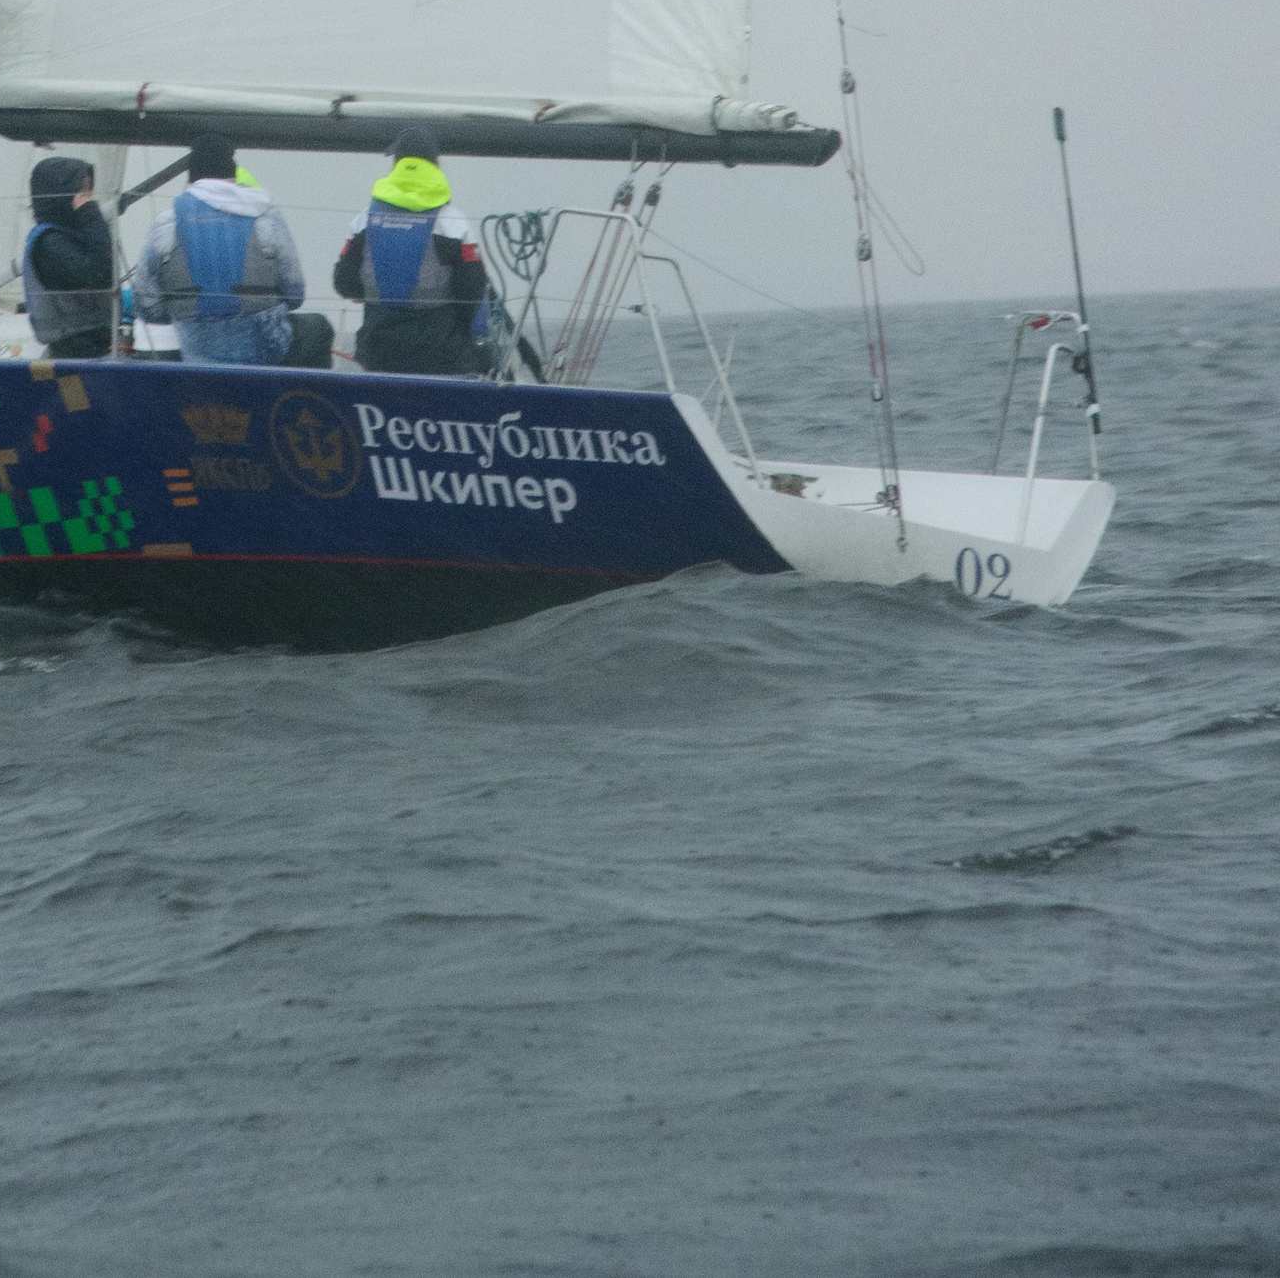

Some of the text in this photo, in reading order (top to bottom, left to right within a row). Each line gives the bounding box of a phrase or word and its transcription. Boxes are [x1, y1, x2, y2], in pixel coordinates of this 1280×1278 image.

[353, 403, 667, 468] Республика
[369, 455, 577, 523] Шкипер
[955, 547, 1013, 601] 02
